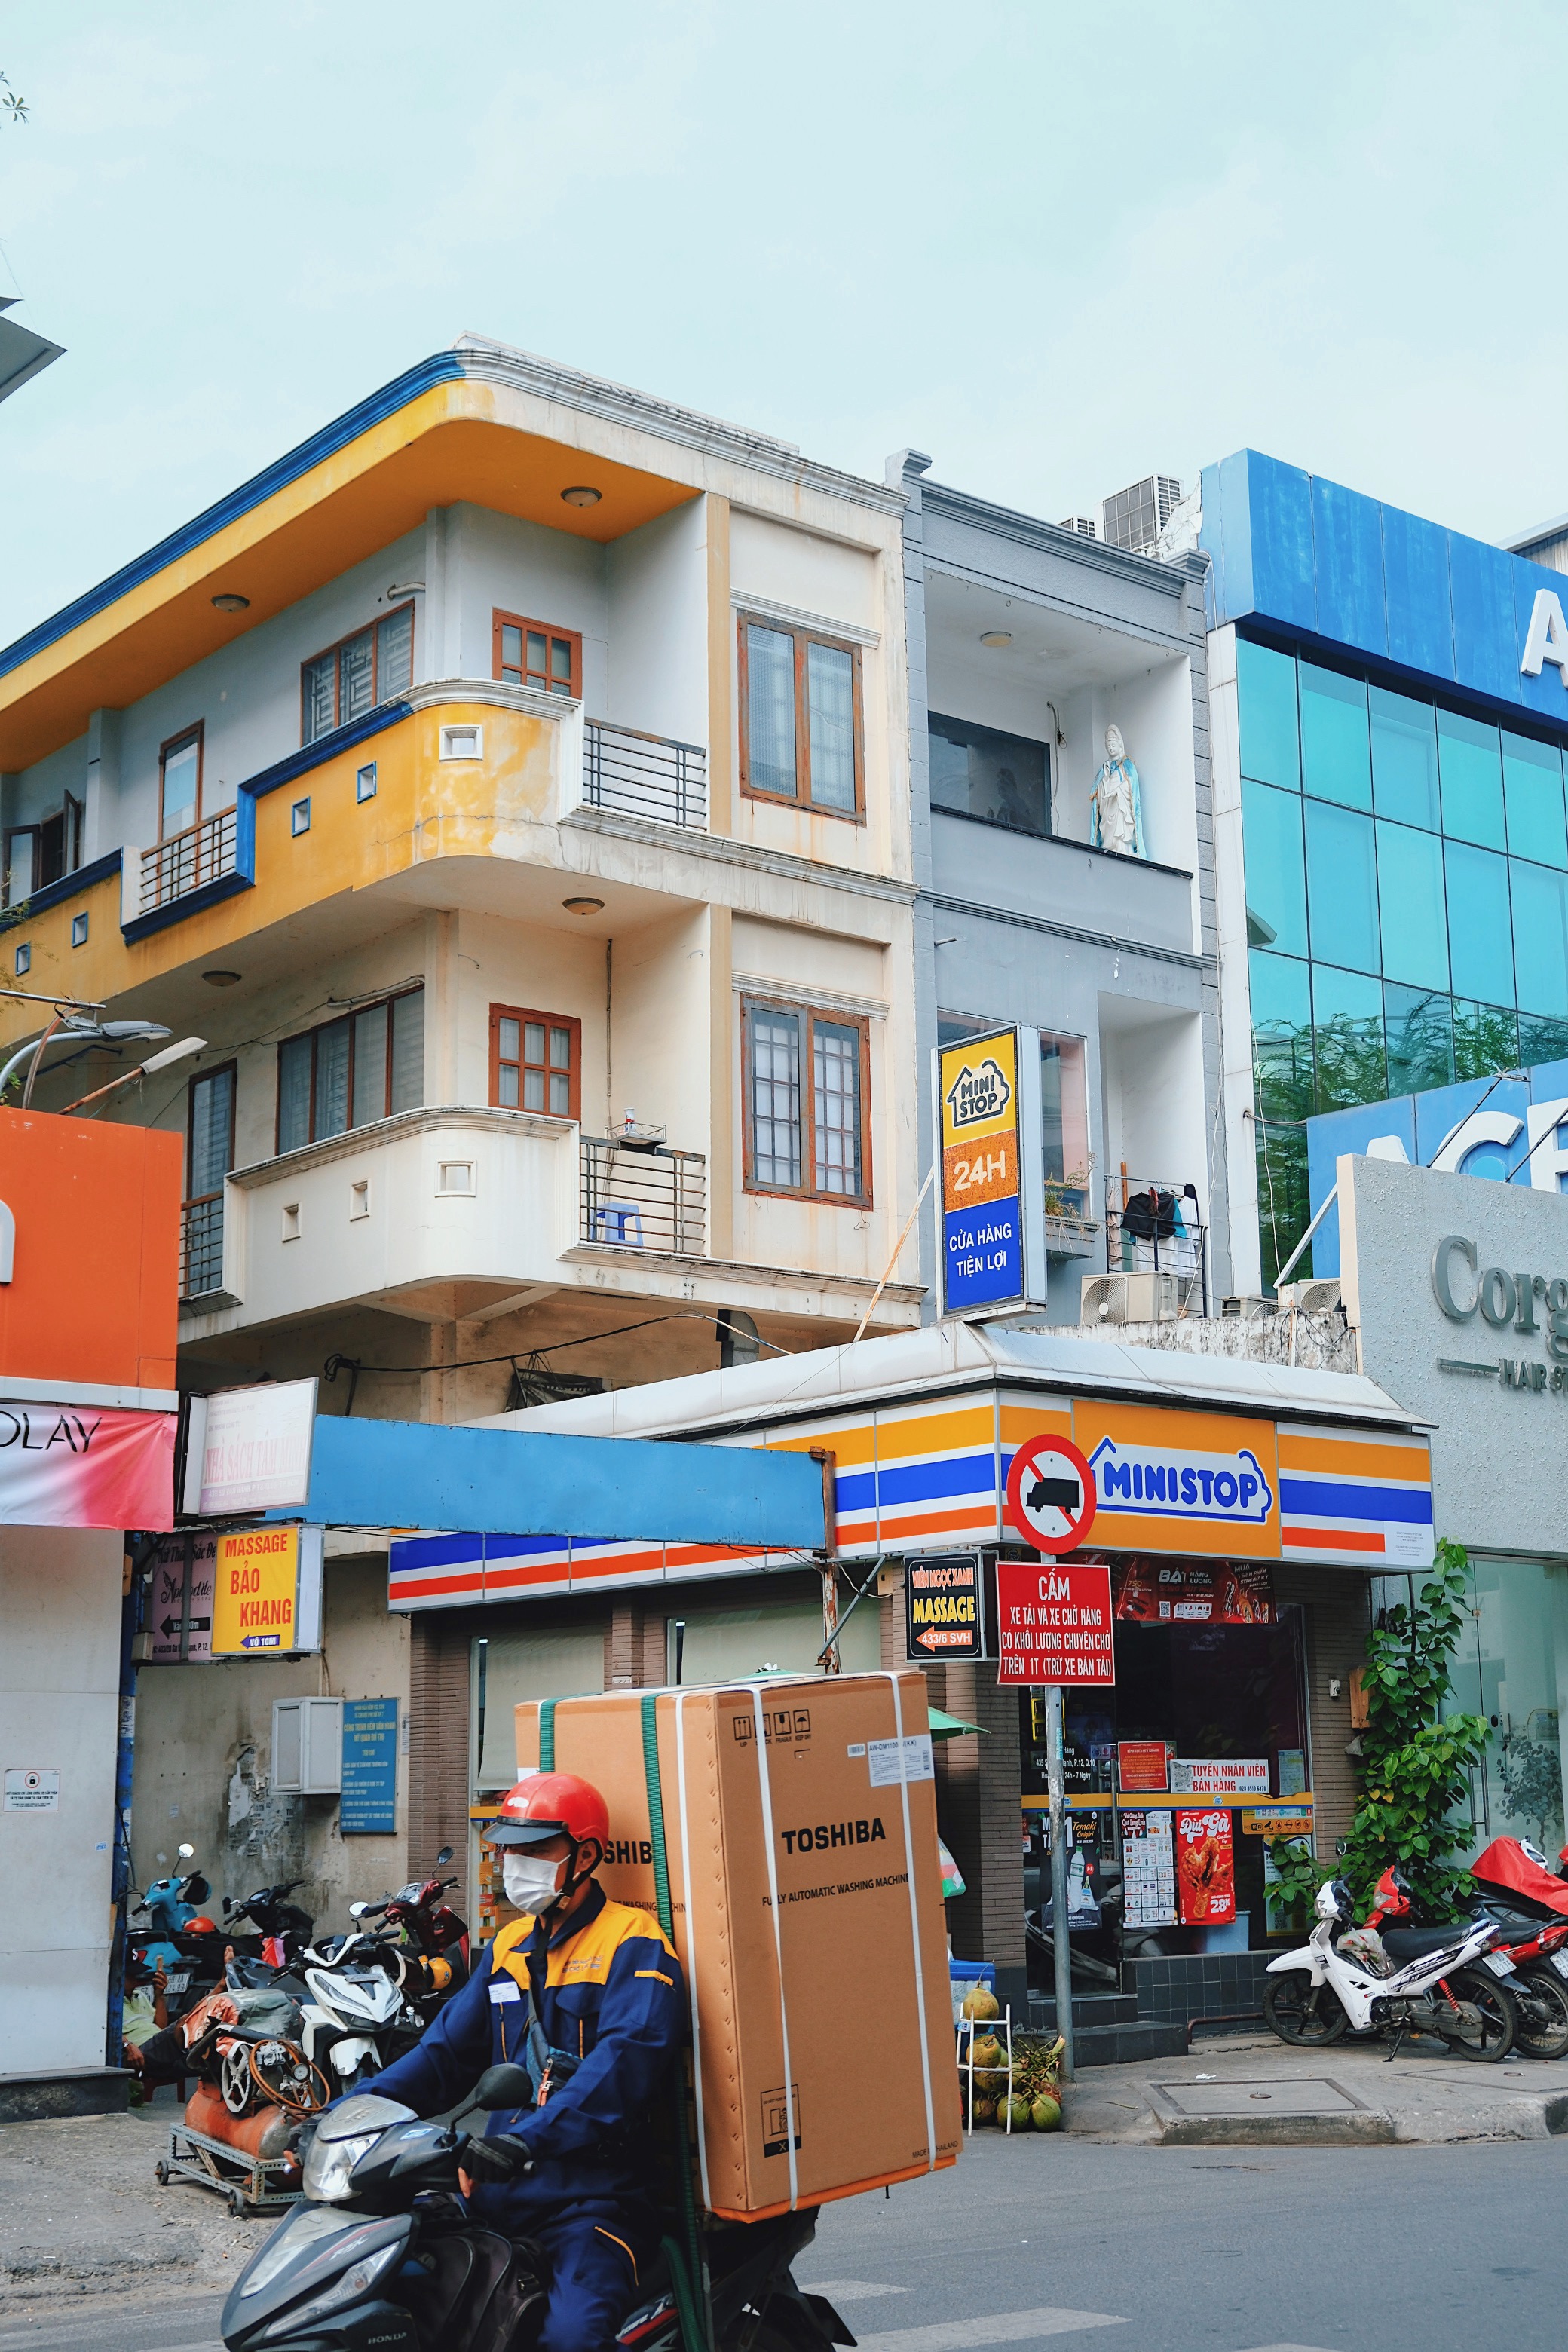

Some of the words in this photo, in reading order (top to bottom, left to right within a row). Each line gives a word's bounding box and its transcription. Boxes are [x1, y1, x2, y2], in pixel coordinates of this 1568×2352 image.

[960, 1075, 994, 1099] MINI
[960, 1095, 997, 1117] STOP
[954, 1150, 1006, 1192] 24H
[949, 1227, 975, 1252] CỬA
[977, 1222, 1012, 1246] HÀNG
[956, 1254, 984, 1279] TIỆN
[986, 1248, 1007, 1272] LỢI
[1499, 1358, 1548, 1389] HAIR
[1104, 1461, 1260, 1508] MINISTOP
[225, 1533, 288, 1558] MASSAGE
[231, 1560, 260, 1595] BẢO
[929, 1568, 952, 1591] NGỌC
[951, 1567, 974, 1586] XANH
[1038, 1568, 1070, 1601] CẤM
[240, 1597, 292, 1628] KHANG
[913, 1596, 975, 1624] MASSAGE
[1010, 1607, 1021, 1625] XE
[1022, 1603, 1035, 1625] TẢI
[1037, 1605, 1047, 1625] VÀ
[1049, 1607, 1060, 1625] XE
[1062, 1604, 1078, 1625] CHỞ
[1080, 1605, 1101, 1626] HÀNG
[261, 1636, 277, 1646] 10M
[922, 1632, 947, 1645] 433/6
[950, 1631, 971, 1644] SVH
[1002, 1631, 1012, 1649] CÓ
[1014, 1627, 1033, 1649] KHỐI
[1035, 1631, 1061, 1653] LƯỢNG
[1064, 1628, 1094, 1651] CHUYÊN
[1095, 1630, 1110, 1652] CHỞ
[1003, 1653, 1024, 1675] TRÊN
[1031, 1657, 1039, 1675] 1T
[1043, 1656, 1063, 1677] (TRỪ
[1065, 1658, 1076, 1675] XE
[1077, 1655, 1095, 1676] BÁN
[1096, 1656, 1111, 1677] TẢI)
[1063, 1759, 1073, 1769] ạnh,
[1193, 1760, 1219, 1777] TUYỂN
[1221, 1762, 1245, 1777] NHÂN
[1247, 1762, 1266, 1777] VIÊN
[1080, 1772, 1091, 1781] Ngày
[1193, 1778, 1211, 1792] BÁN
[1213, 1778, 1236, 1792] HÀNG
[781, 1818, 886, 1854] TOSHIBA
[1073, 1821, 1098, 1830] Temaki
[1076, 1830, 1095, 1839] Onigiri
[1202, 1812, 1230, 1837] Gà
[603, 1840, 652, 1864] SHIB
[762, 1894, 786, 1907] FULY
[788, 1885, 836, 1903] AUTOMATIC
[837, 1878, 874, 1895] WASHING
[912, 2148, 927, 2158] MADE
[936, 2140, 958, 2151] HAILAND
[367, 2332, 407, 2344] HONDA
